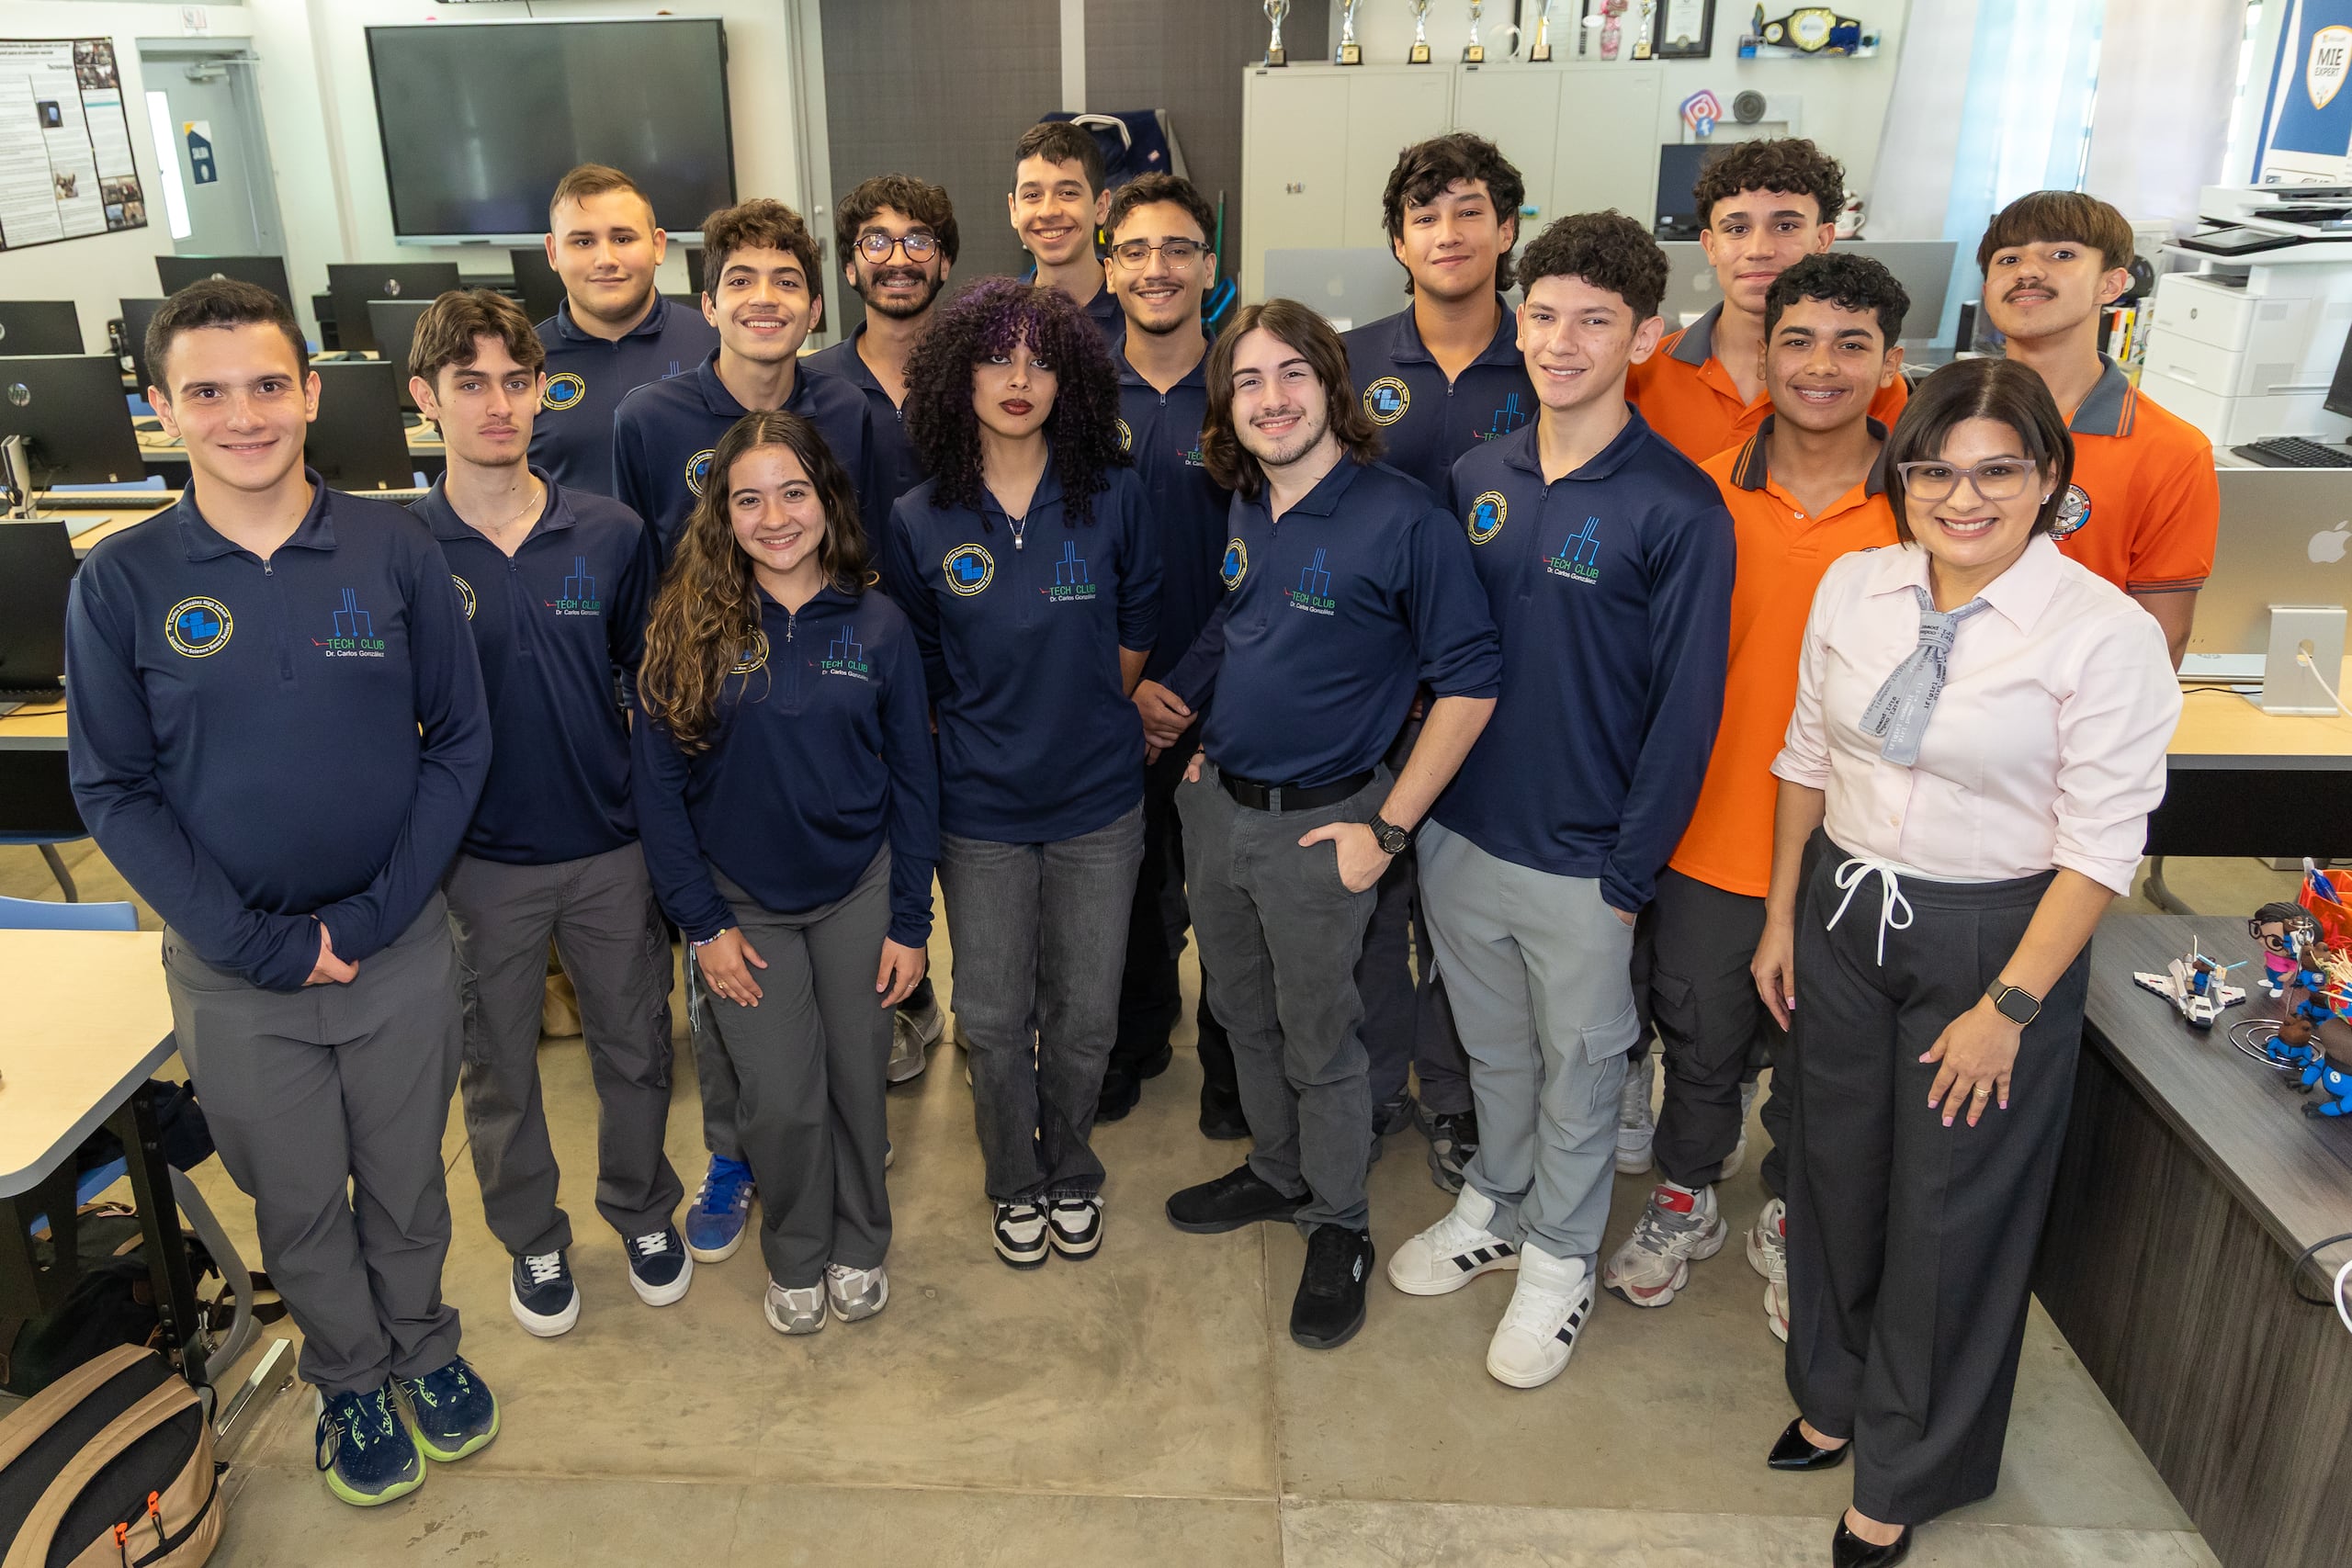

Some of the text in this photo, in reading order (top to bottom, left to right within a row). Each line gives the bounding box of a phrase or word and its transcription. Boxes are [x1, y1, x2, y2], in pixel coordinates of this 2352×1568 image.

[2317, 48, 2343, 66] MIE
[2315, 67, 2340, 76] EXPERT
[1550, 557, 1599, 578] TECH CLUB
[1554, 569, 1571, 578] Carlos
[1049, 584, 1096, 596] TECH CLUB
[555, 599, 600, 609] TECH CLUB
[1292, 591, 1335, 609] TECH CLUB
[169, 609, 181, 623] Carlos
[203, 599, 215, 608] High
[215, 604, 229, 618] School
[170, 635, 189, 653] Computer
[209, 638, 224, 651] Honor
[220, 622, 230, 640] Society
[326, 638, 385, 650] TECH CLUB
[821, 660, 868, 673] TECH CLUB
